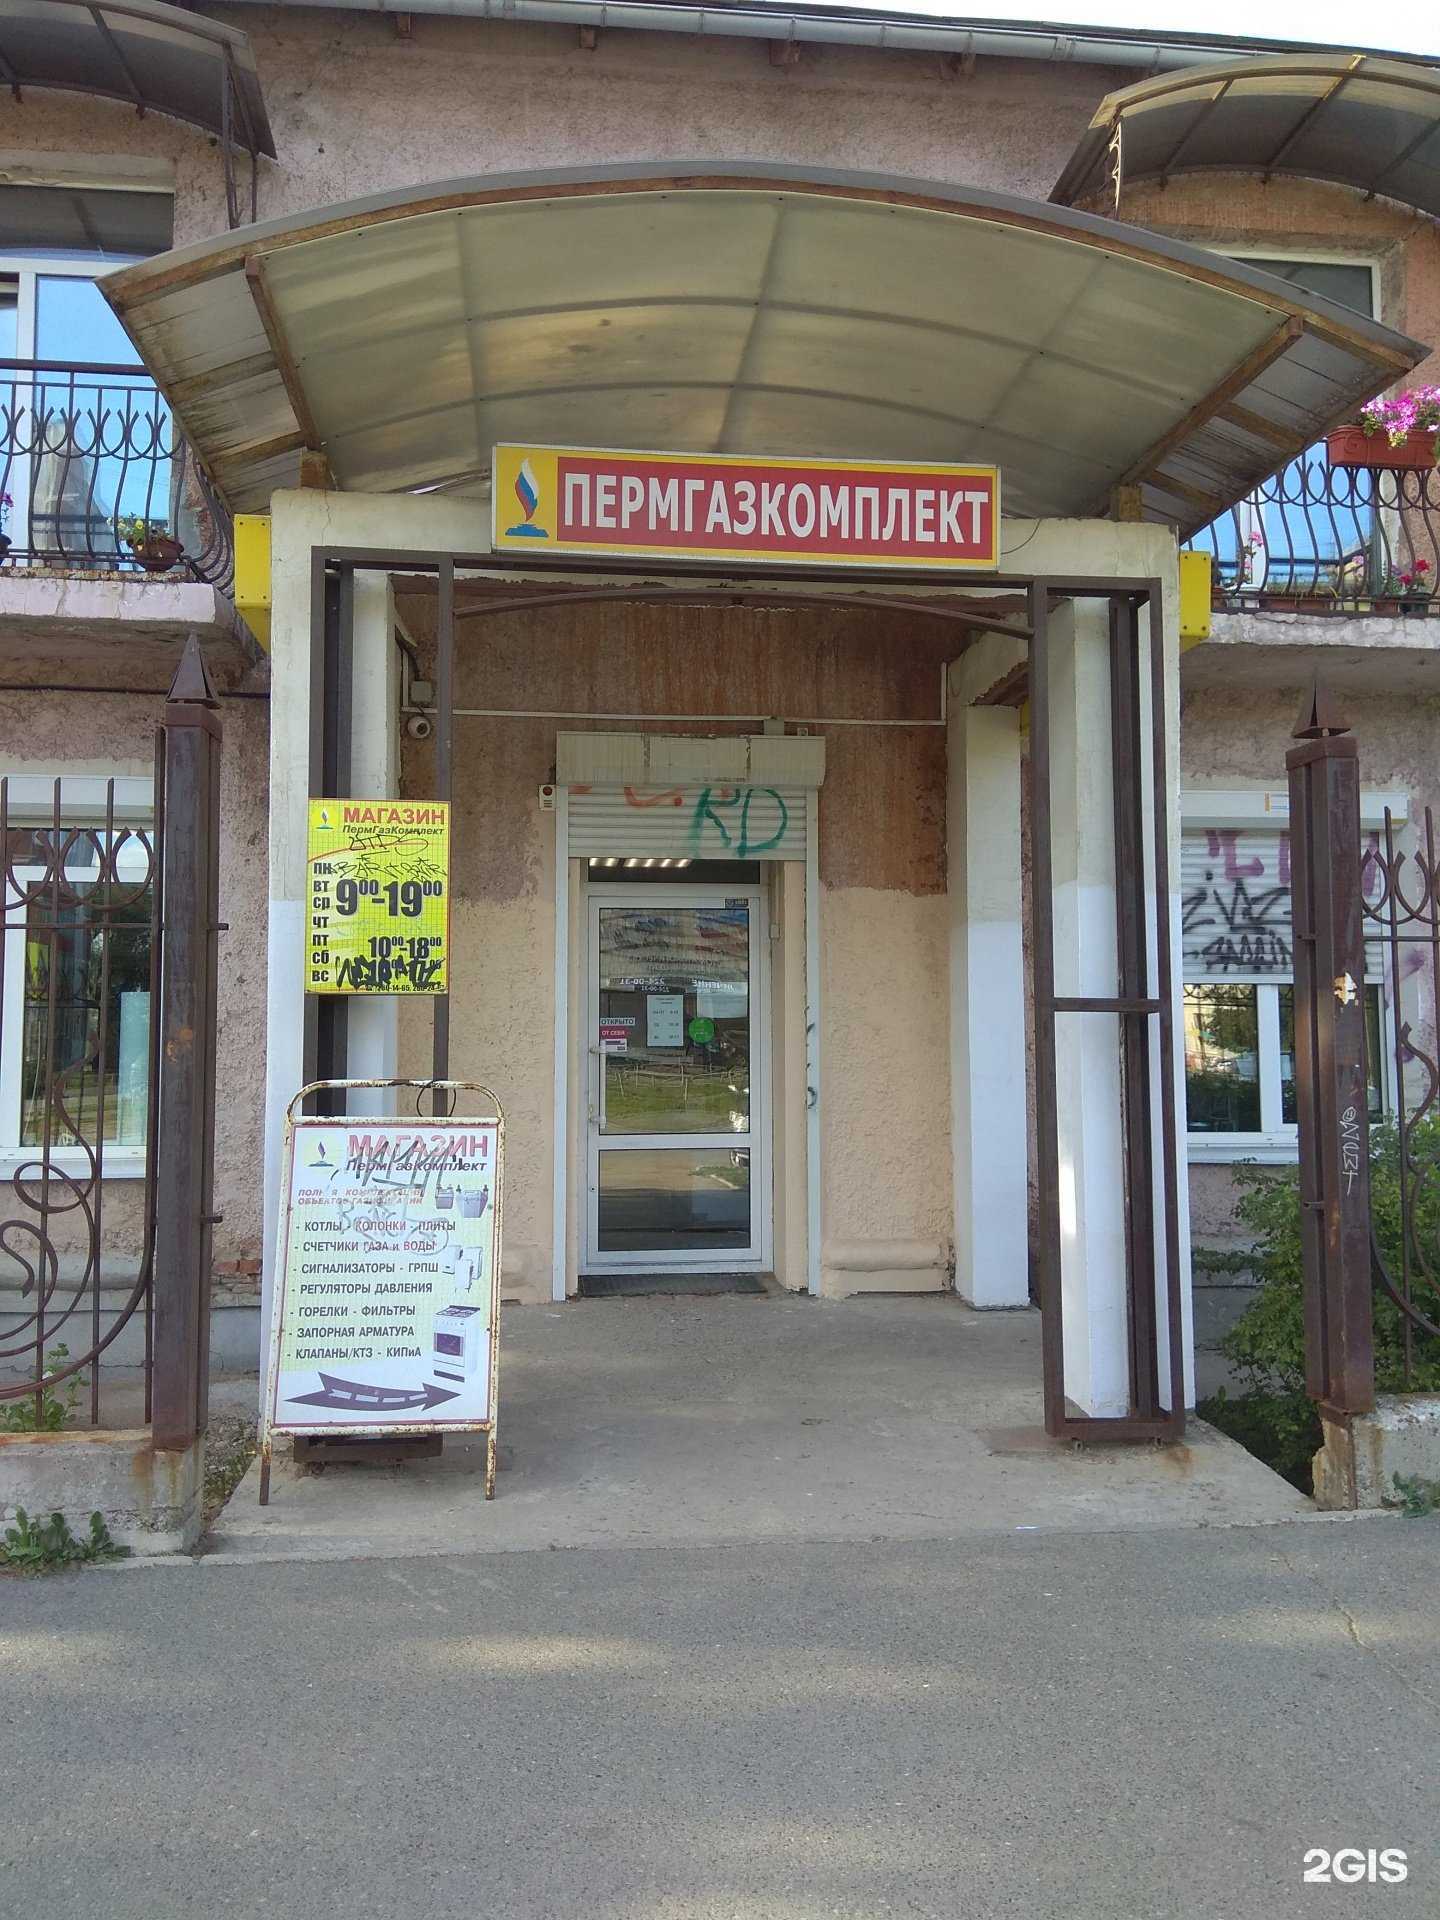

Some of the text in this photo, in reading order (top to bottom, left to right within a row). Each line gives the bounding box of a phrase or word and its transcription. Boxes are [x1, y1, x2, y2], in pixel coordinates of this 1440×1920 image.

[564, 472, 989, 545] ПЕРМГАЗКОМПЛЕКТ
[344, 807, 445, 825] МАГАЗИН
[601, 1018, 634, 1026] ОТКРЫТО
[349, 1135, 488, 1157] МАГАЗИН
[304, 1221, 456, 1231] КОТЛЫ КОЛОНКИ ПЛИТЫ
[303, 1241, 358, 1252] СЧЕТЧИКИ
[363, 1241, 389, 1251] ГАЗА
[404, 1241, 436, 1252] ВОДЫ
[301, 1263, 439, 1274] СИГНАЛИЗАТОРЫ ГРПШ
[300, 1283, 433, 1294] РЕГУЛЯТОРЫ ДАВЛЕНИЯ
[299, 1305, 416, 1317] ГОРЕЛКИ ФИЛЬТРЫ
[297, 1326, 415, 1338] ЗАПОРНАЯ АРМАТУРА
[386, 1347, 421, 1357] КИПиА
